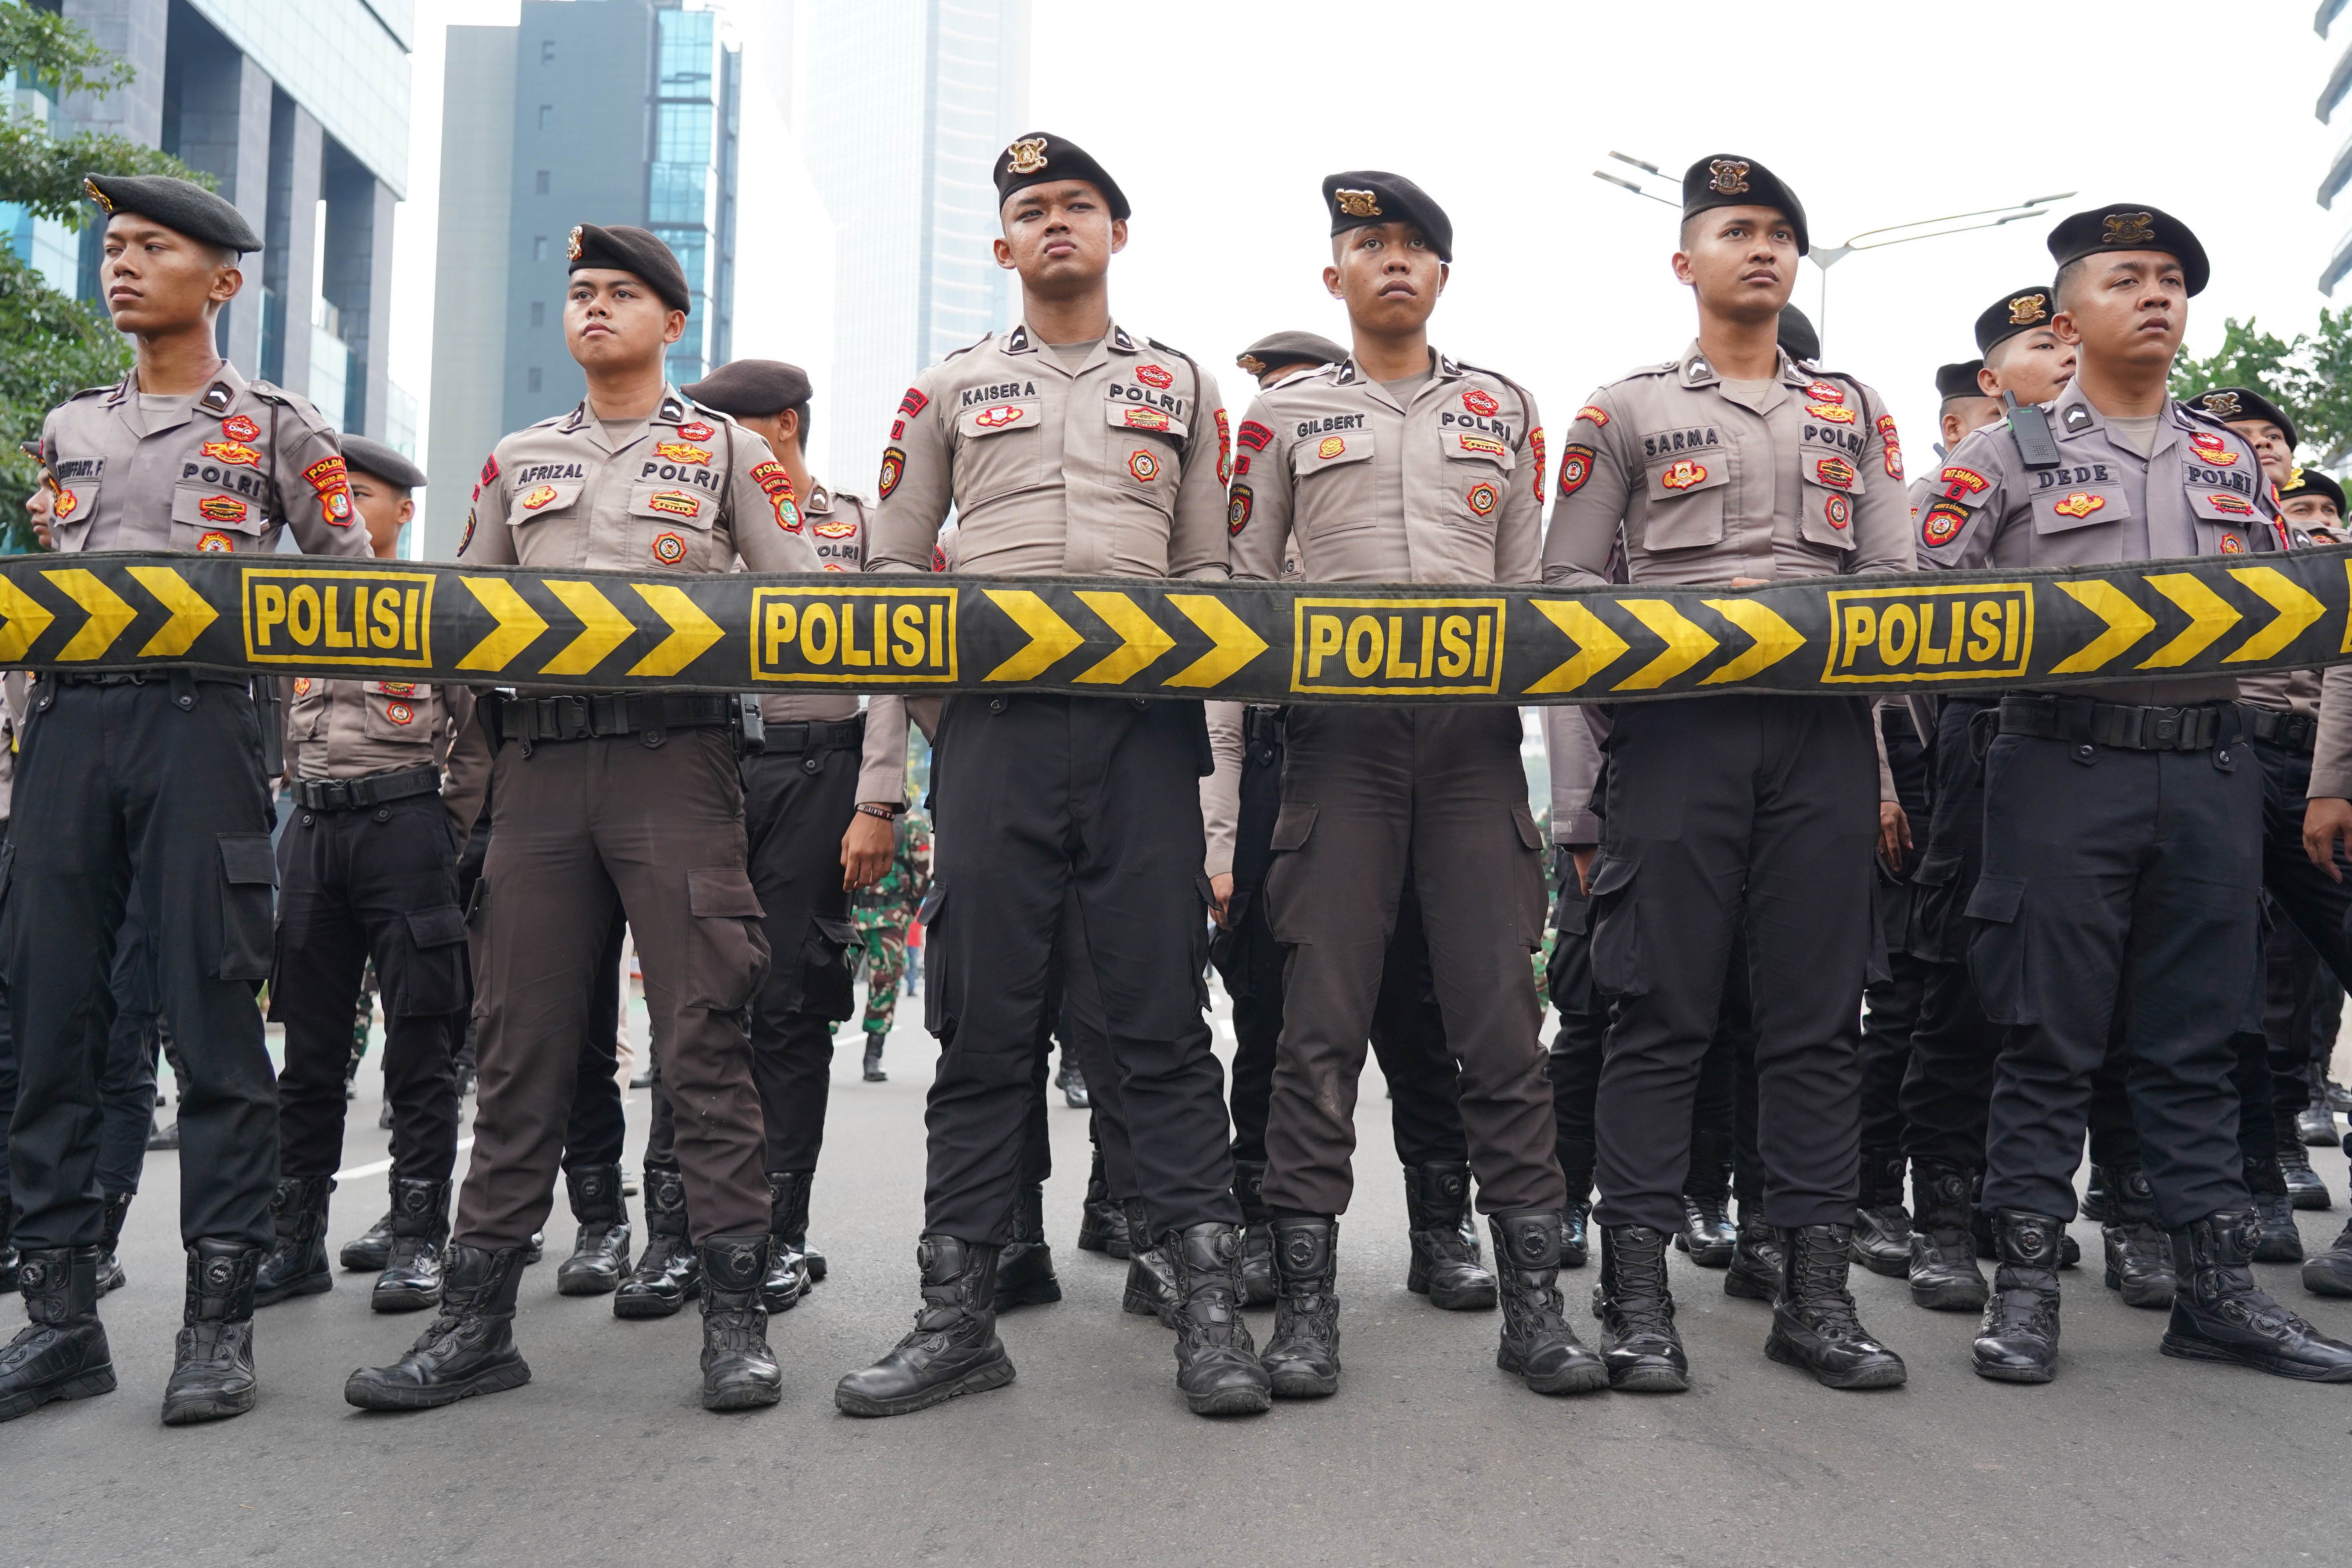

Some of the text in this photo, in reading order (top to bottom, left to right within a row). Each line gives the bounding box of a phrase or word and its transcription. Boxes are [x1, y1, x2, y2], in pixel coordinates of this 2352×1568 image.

[963, 381, 1036, 406] KAISER A
[1110, 383, 1182, 415] POLRI
[1297, 413, 1364, 437] GILBERT
[1442, 412, 1510, 441] POLRI
[1644, 428, 1718, 456] SARMA
[1805, 424, 1864, 456] POLRI
[95, 460, 104, 476] F
[309, 459, 343, 479] POLDA
[518, 463, 583, 485] AFRIZAL
[642, 462, 719, 491] POLRI
[756, 463, 786, 478] POLDA
[1237, 459, 1246, 472] 7
[2037, 465, 2108, 488] DEDE
[183, 463, 260, 496] POLRI
[317, 476, 336, 488] METRO
[765, 479, 781, 490] METRO
[1944, 469, 1984, 490] DIT SAMAPTA
[1951, 486, 1962, 496] 6
[2188, 466, 2251, 494] POLRI
[814, 544, 859, 560] OLRI
[255, 584, 420, 651] POLISI
[765, 602, 943, 667] POLISI
[1841, 599, 2020, 668] POLISI
[1307, 615, 1491, 679] POLISI
[26, 1269, 37, 1282] PMJ
[213, 1269, 227, 1278] PMJ
